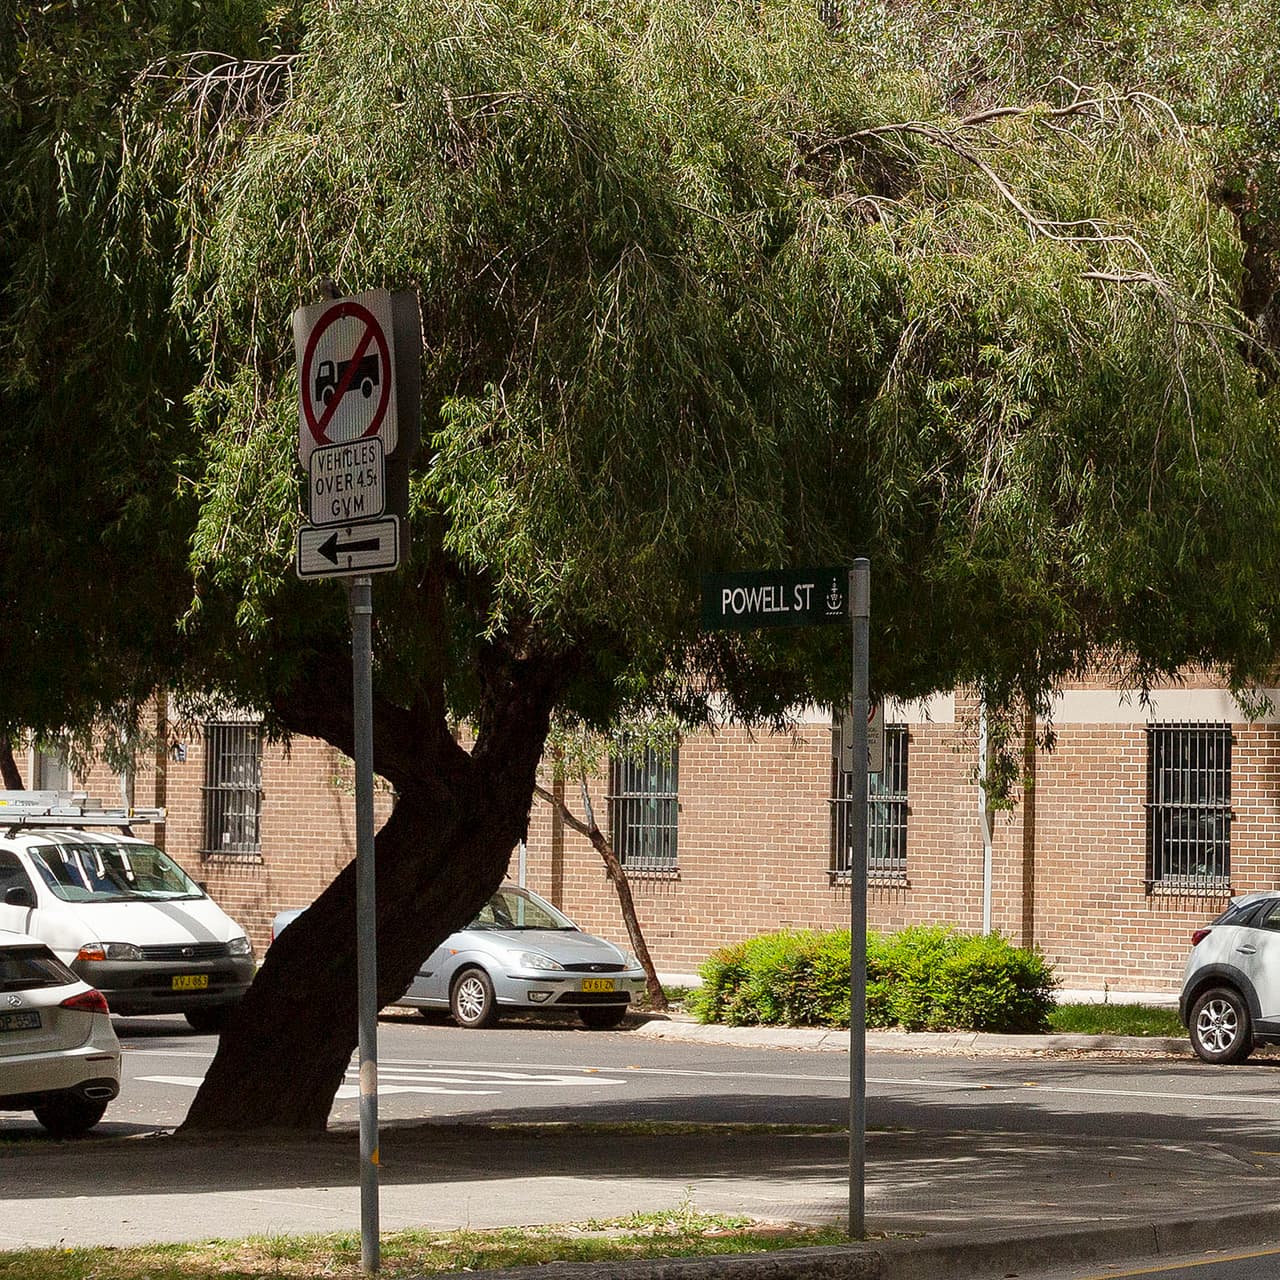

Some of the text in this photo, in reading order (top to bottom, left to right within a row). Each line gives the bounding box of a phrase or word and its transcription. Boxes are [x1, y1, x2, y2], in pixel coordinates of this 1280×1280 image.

[318, 445, 376, 473] VEHICLES
[315, 473, 353, 495] OVER
[331, 495, 364, 517] GVM
[722, 583, 815, 615] POWELL ST
